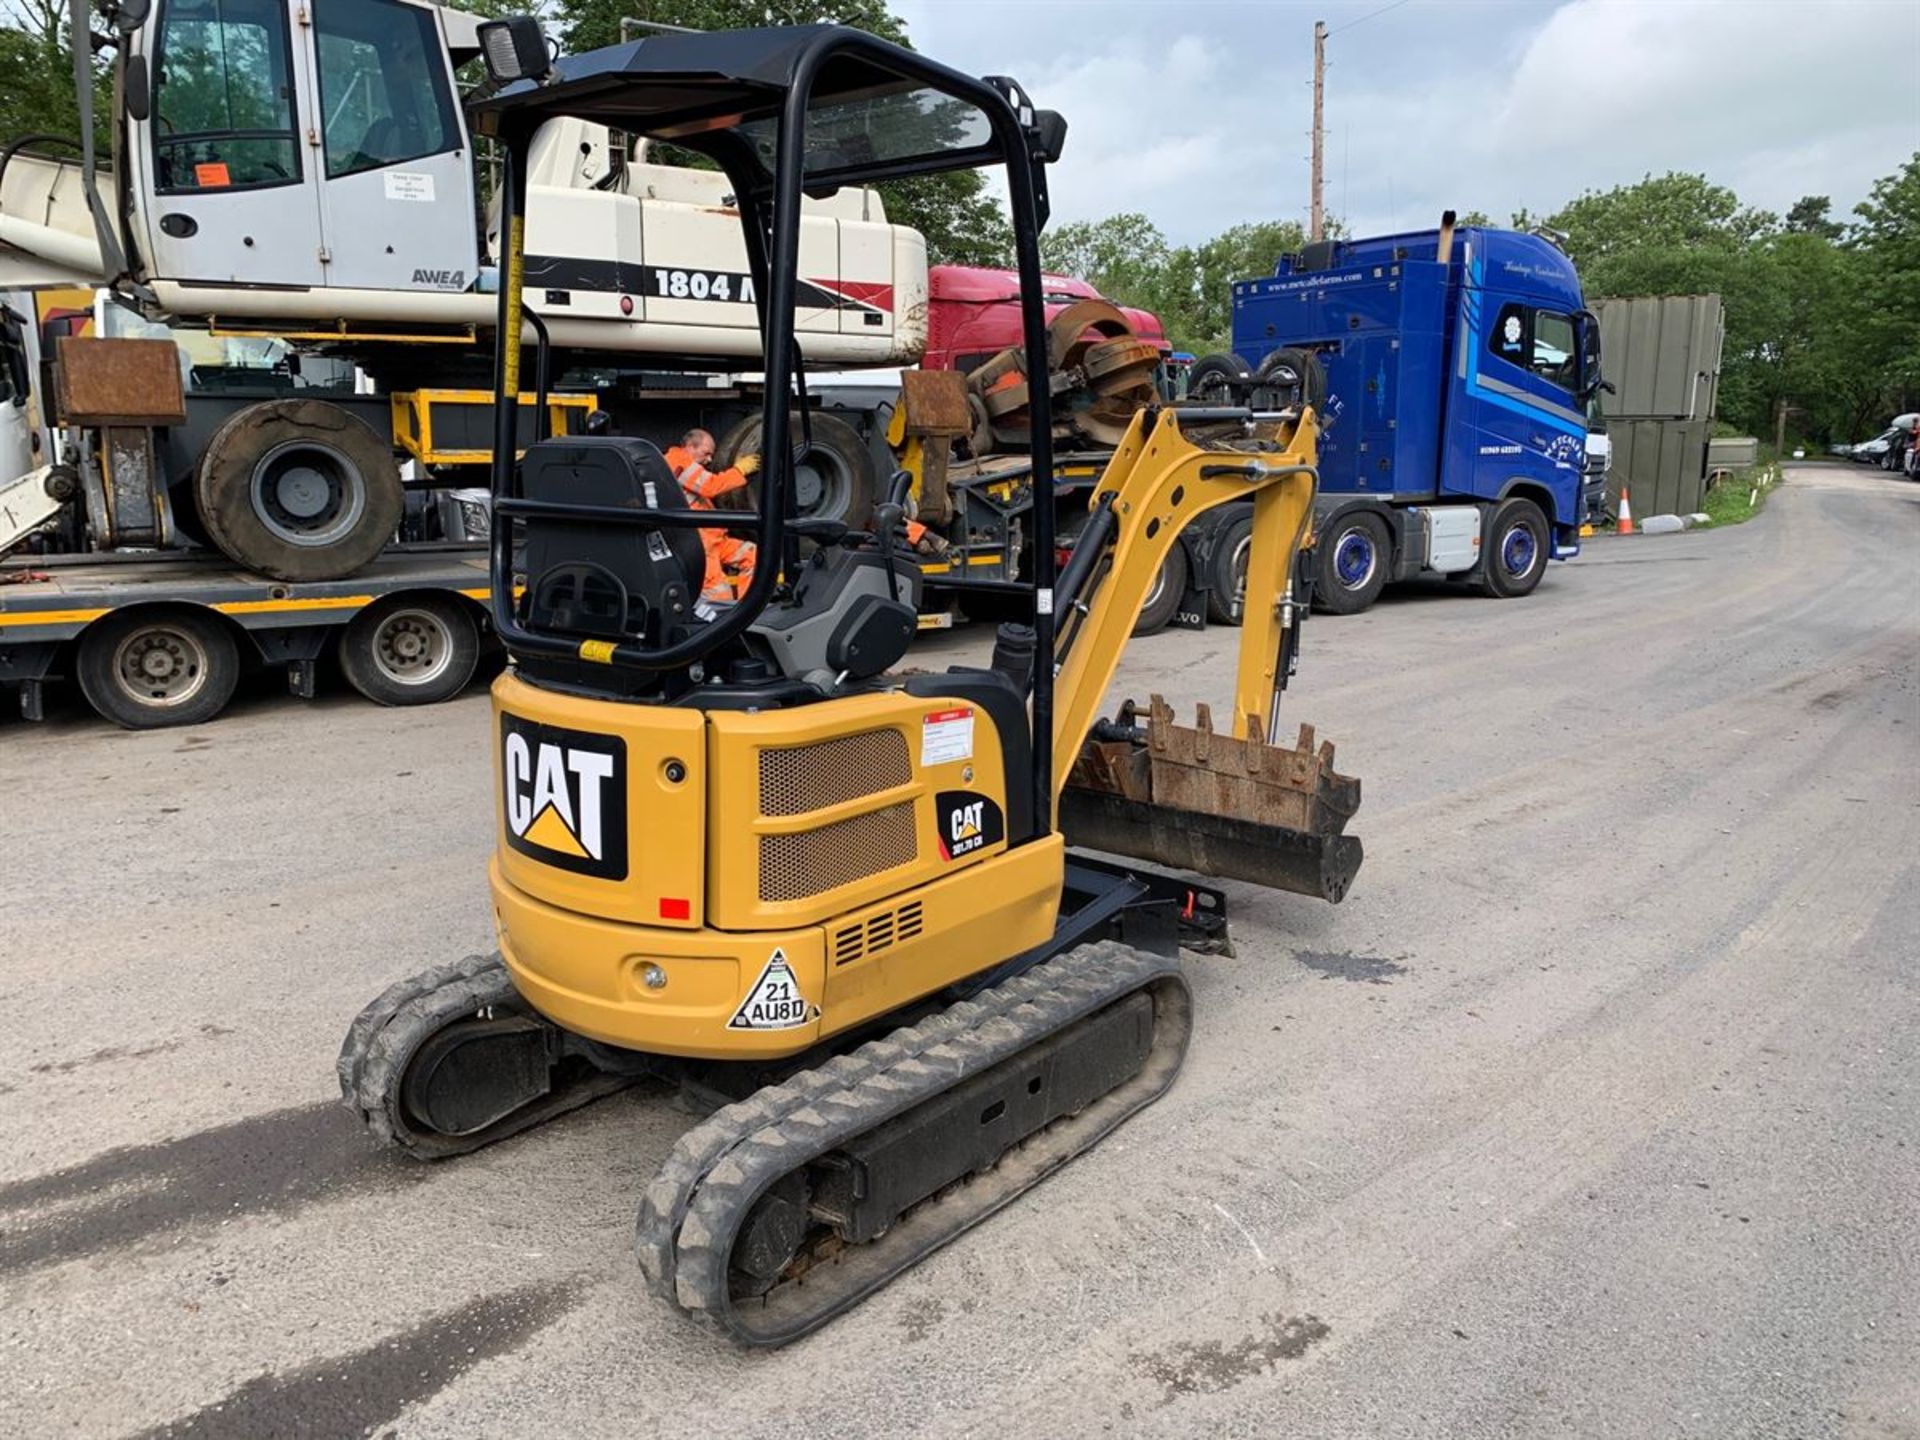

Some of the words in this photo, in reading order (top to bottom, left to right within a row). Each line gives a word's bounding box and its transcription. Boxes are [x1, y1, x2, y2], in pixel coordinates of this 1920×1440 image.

[411, 268, 465, 289] AWE4
[655, 269, 731, 301] 1804
[506, 732, 613, 861] CAT
[951, 801, 984, 841] CAT
[765, 982, 791, 1002] 21
[751, 999, 805, 1021] AU8D
